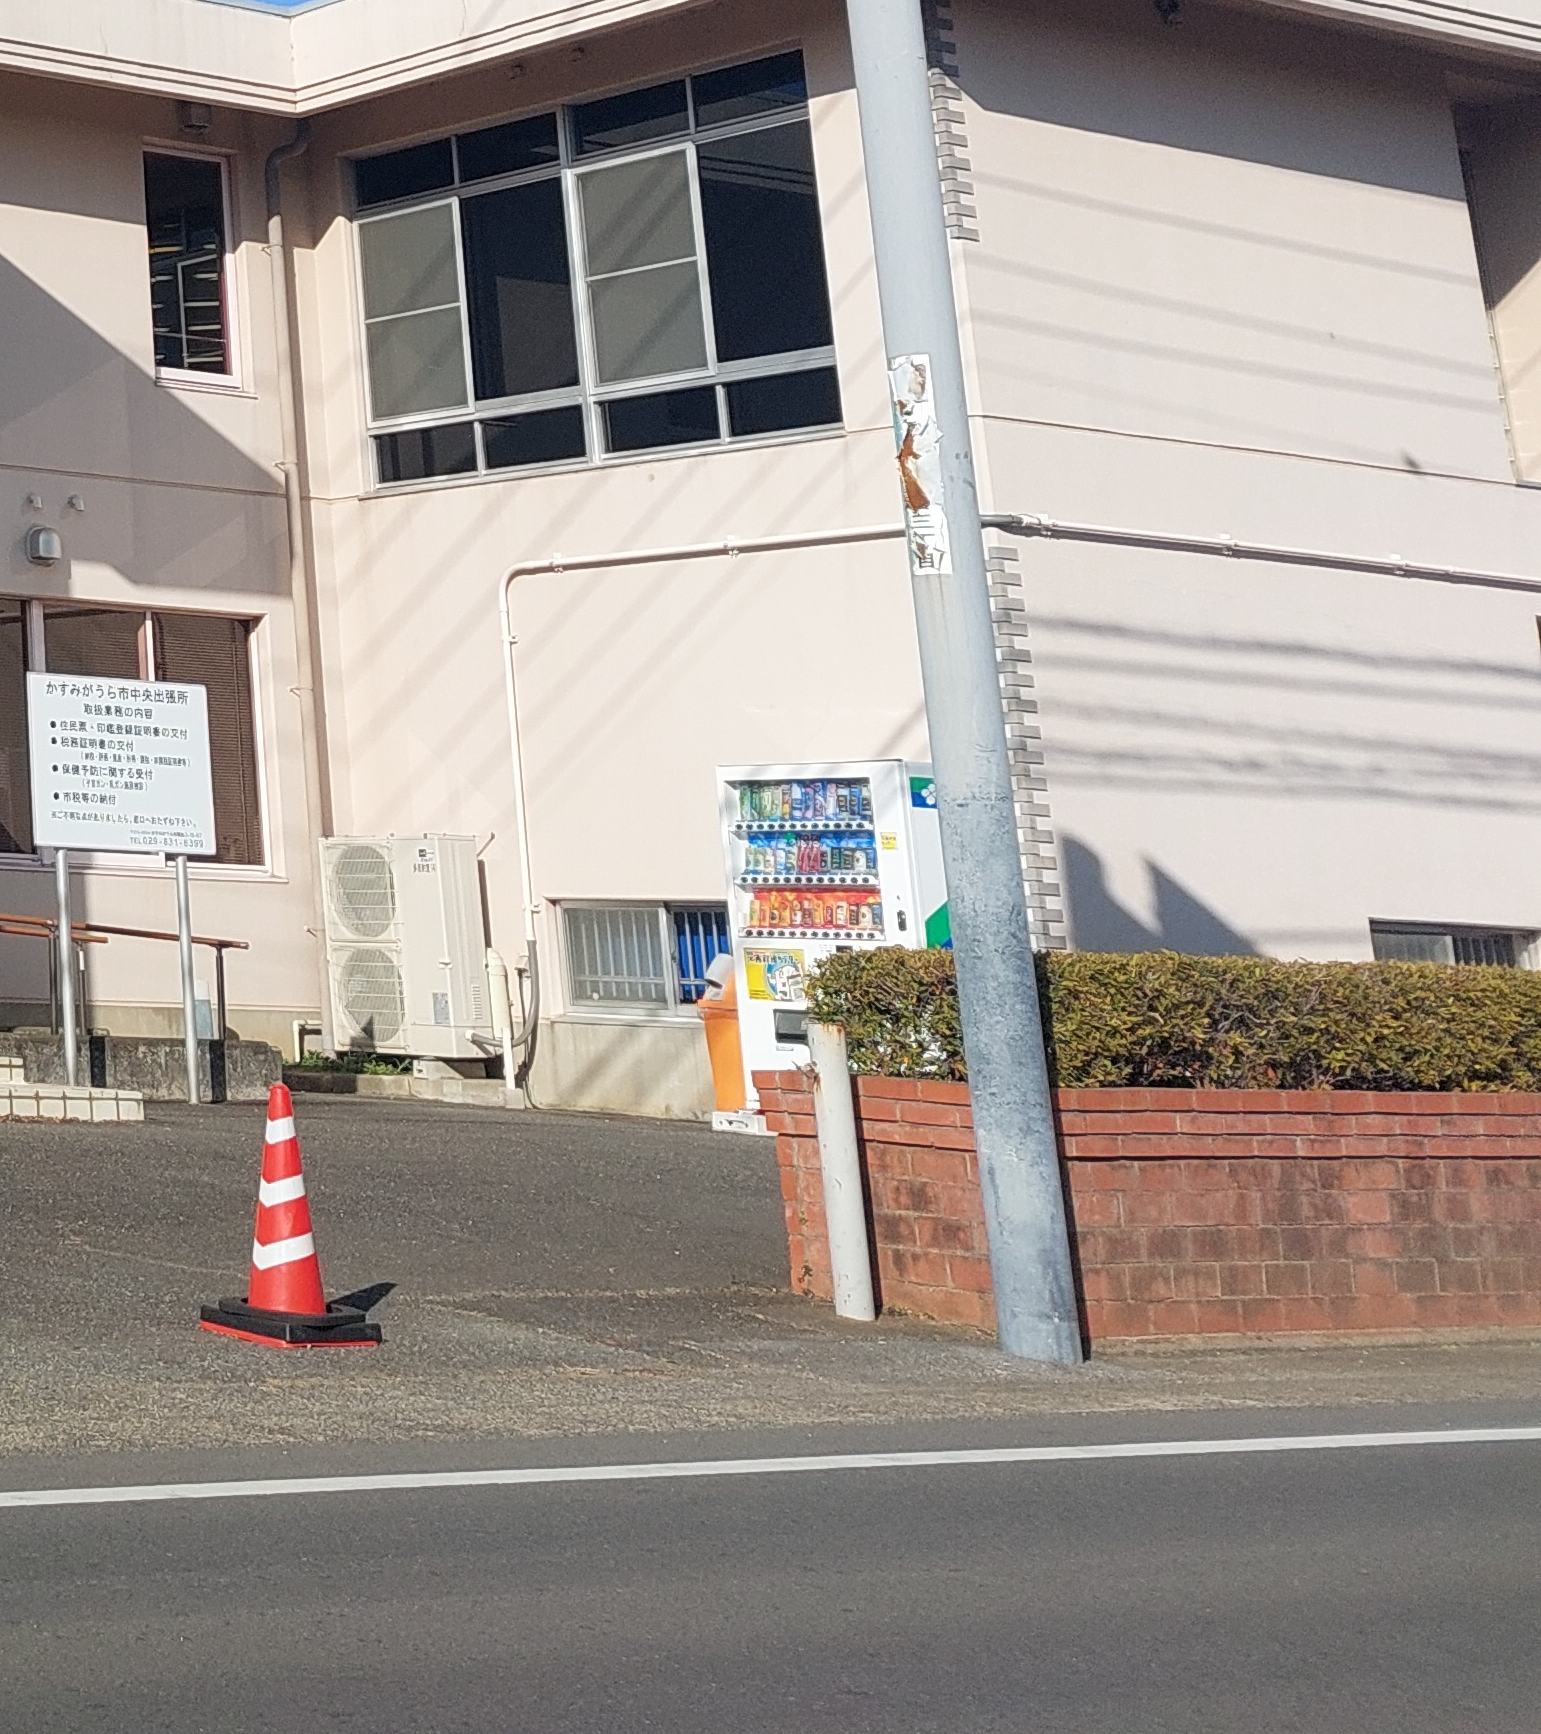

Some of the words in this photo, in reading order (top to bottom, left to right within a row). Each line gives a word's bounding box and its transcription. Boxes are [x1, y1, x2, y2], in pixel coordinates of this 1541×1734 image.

[46, 680, 189, 706] かすみがうら市中央出張所
